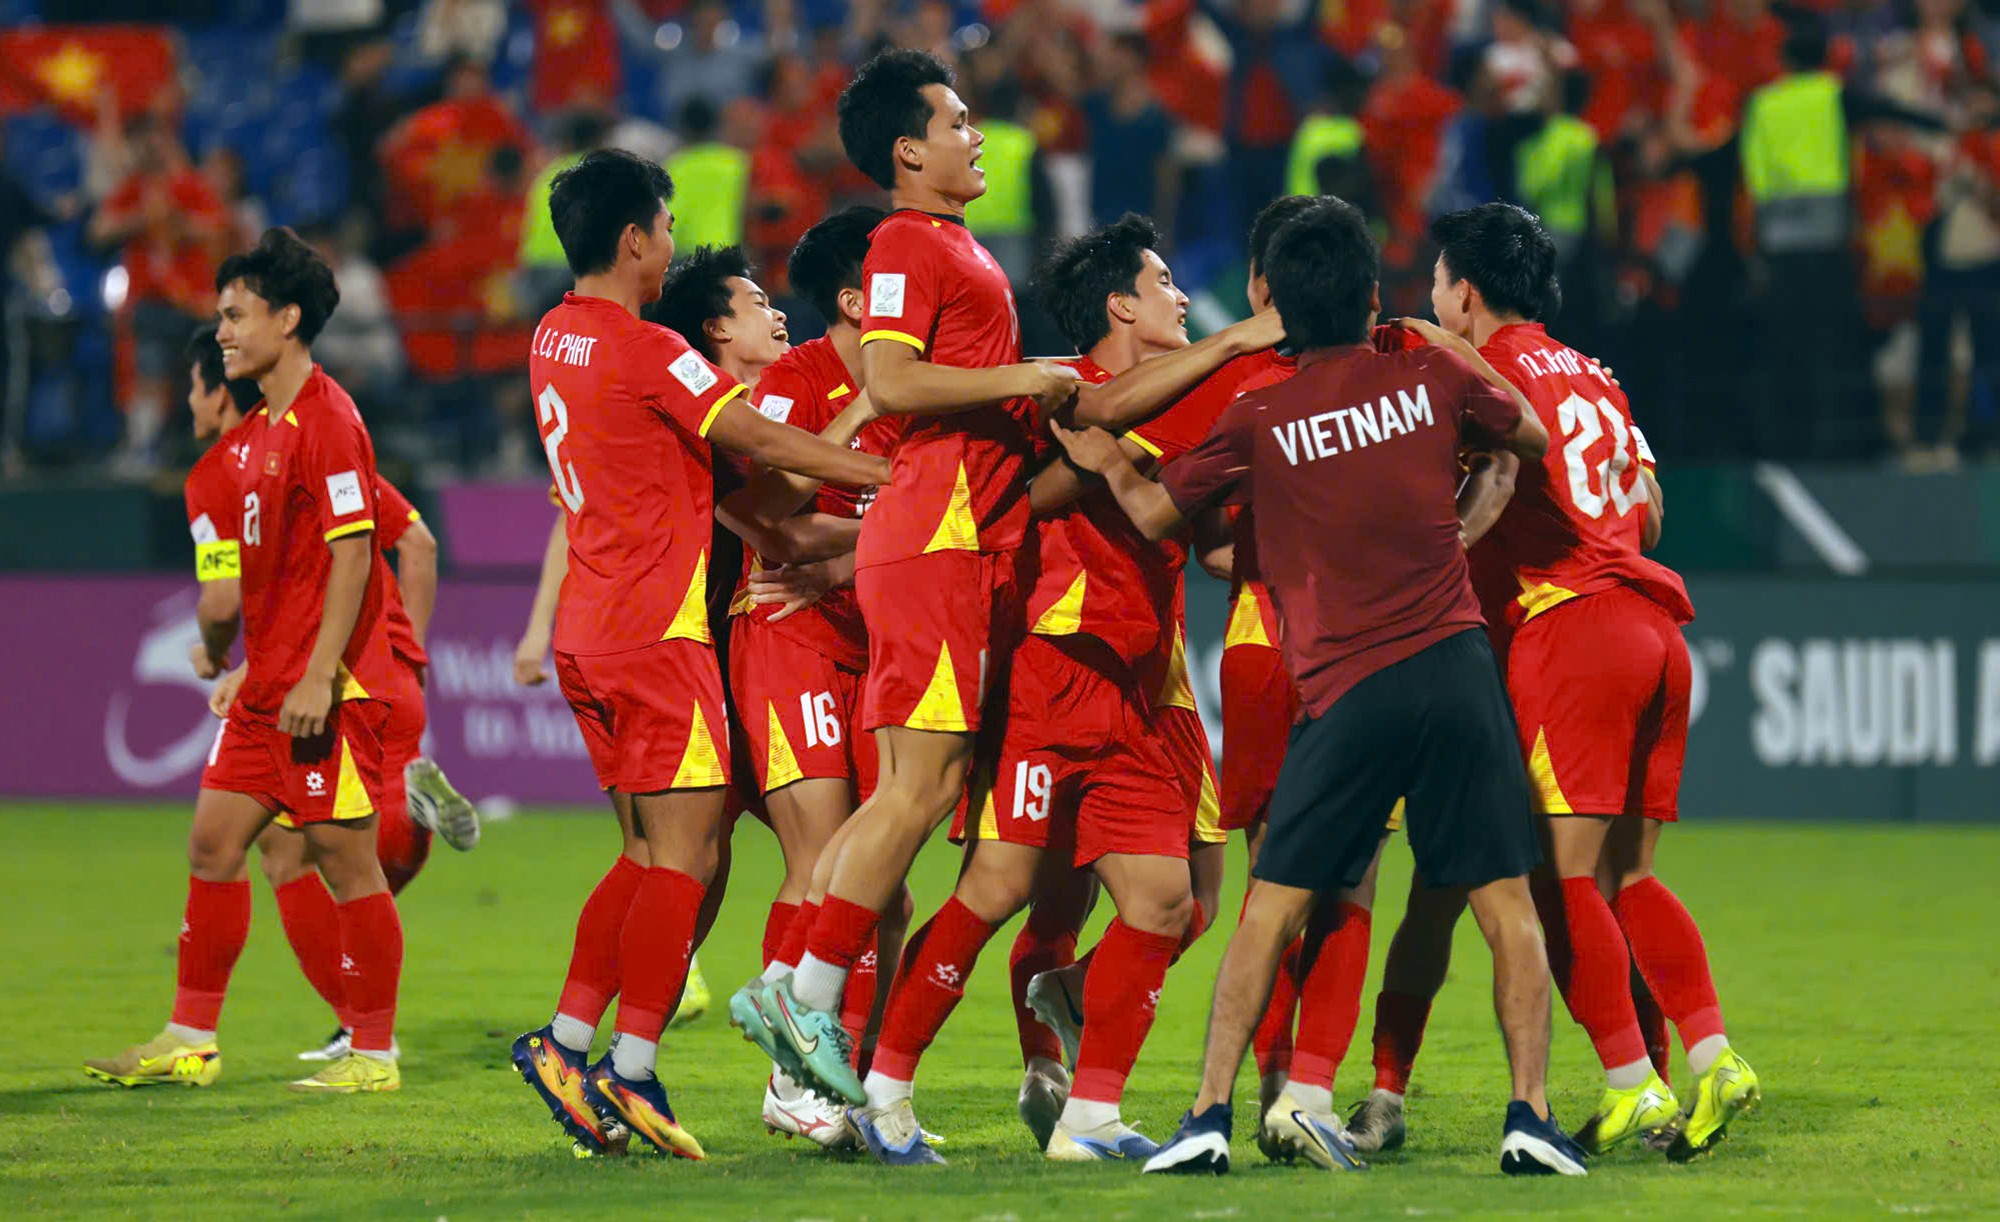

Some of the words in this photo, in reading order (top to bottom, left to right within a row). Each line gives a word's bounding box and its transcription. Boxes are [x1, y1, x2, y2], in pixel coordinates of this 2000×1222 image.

[554, 333, 598, 367] PHAT
[538, 382, 585, 515] 2
[1271, 383, 1435, 467] VIETNAM
[201, 549, 239, 571] AFC
[801, 690, 842, 749] 16
[1752, 636, 1957, 766] SAUDI
[1012, 759, 1053, 823] 19
